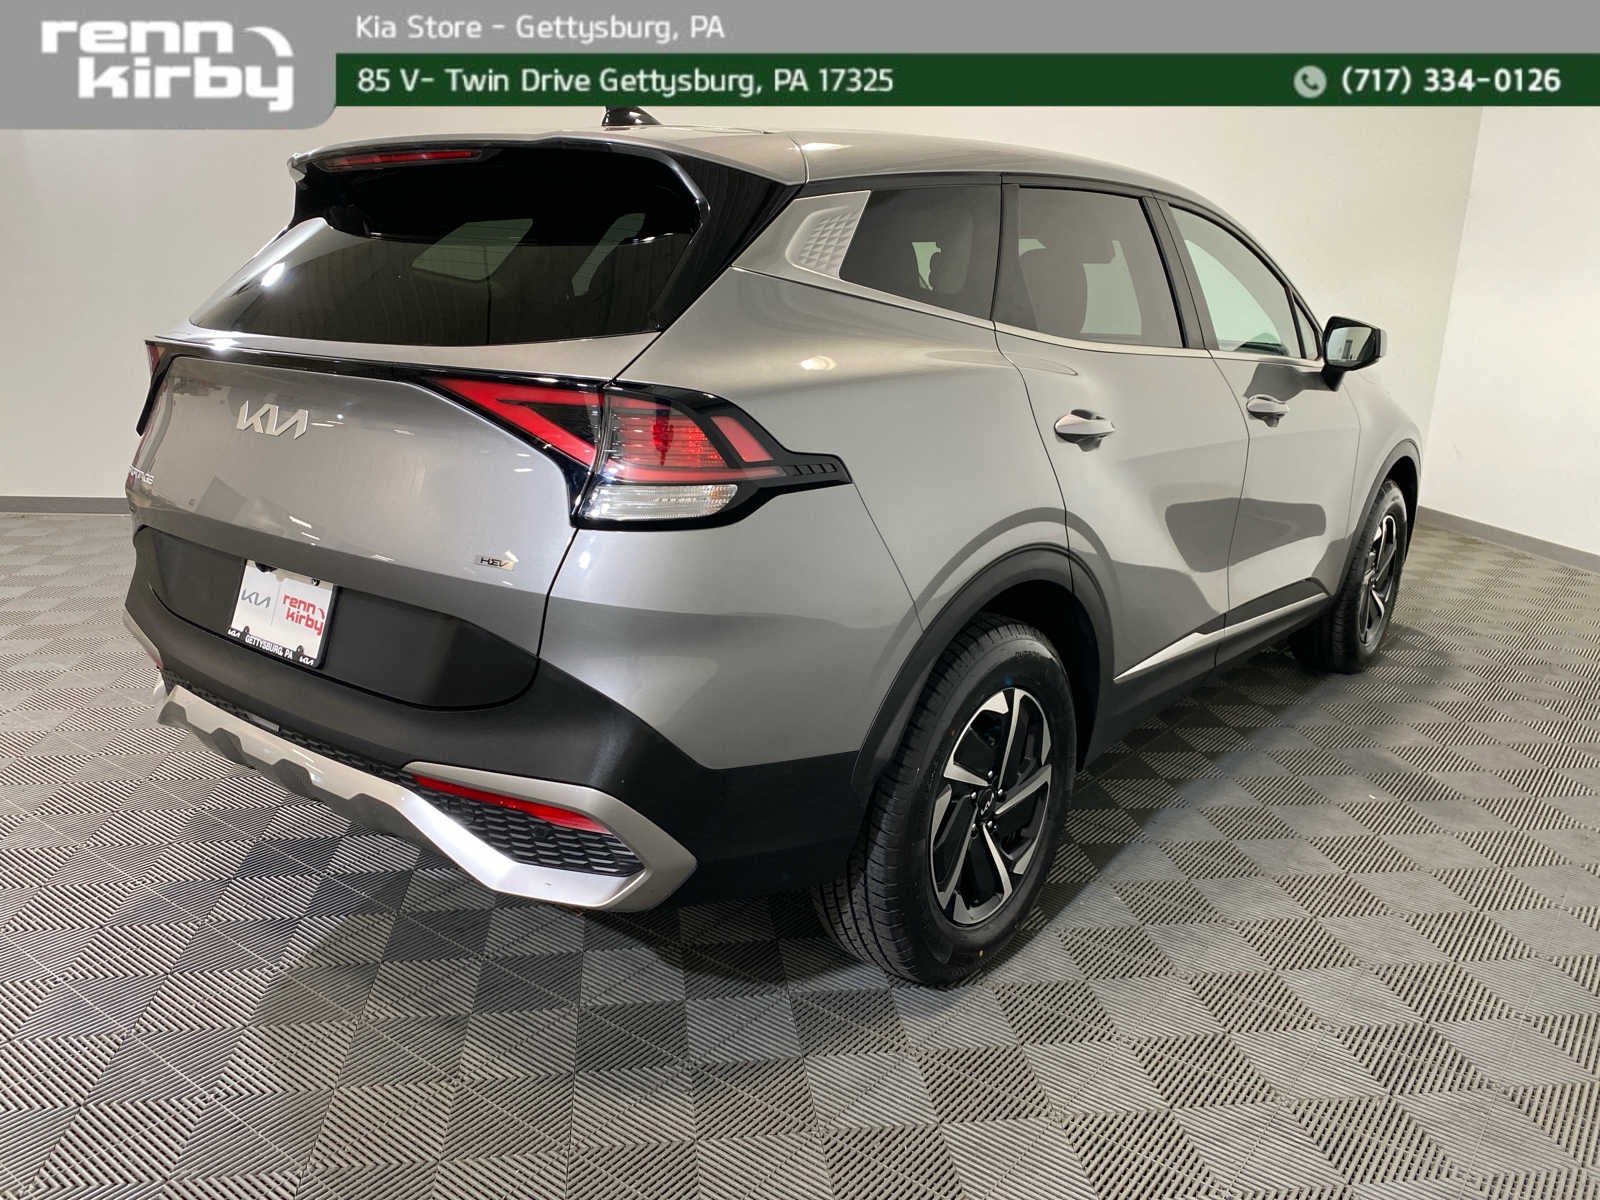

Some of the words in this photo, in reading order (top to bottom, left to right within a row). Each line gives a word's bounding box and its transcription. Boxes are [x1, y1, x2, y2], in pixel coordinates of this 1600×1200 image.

[236, 400, 309, 440] KIA
[282, 594, 317, 614] renn
[285, 608, 324, 636] kirby
